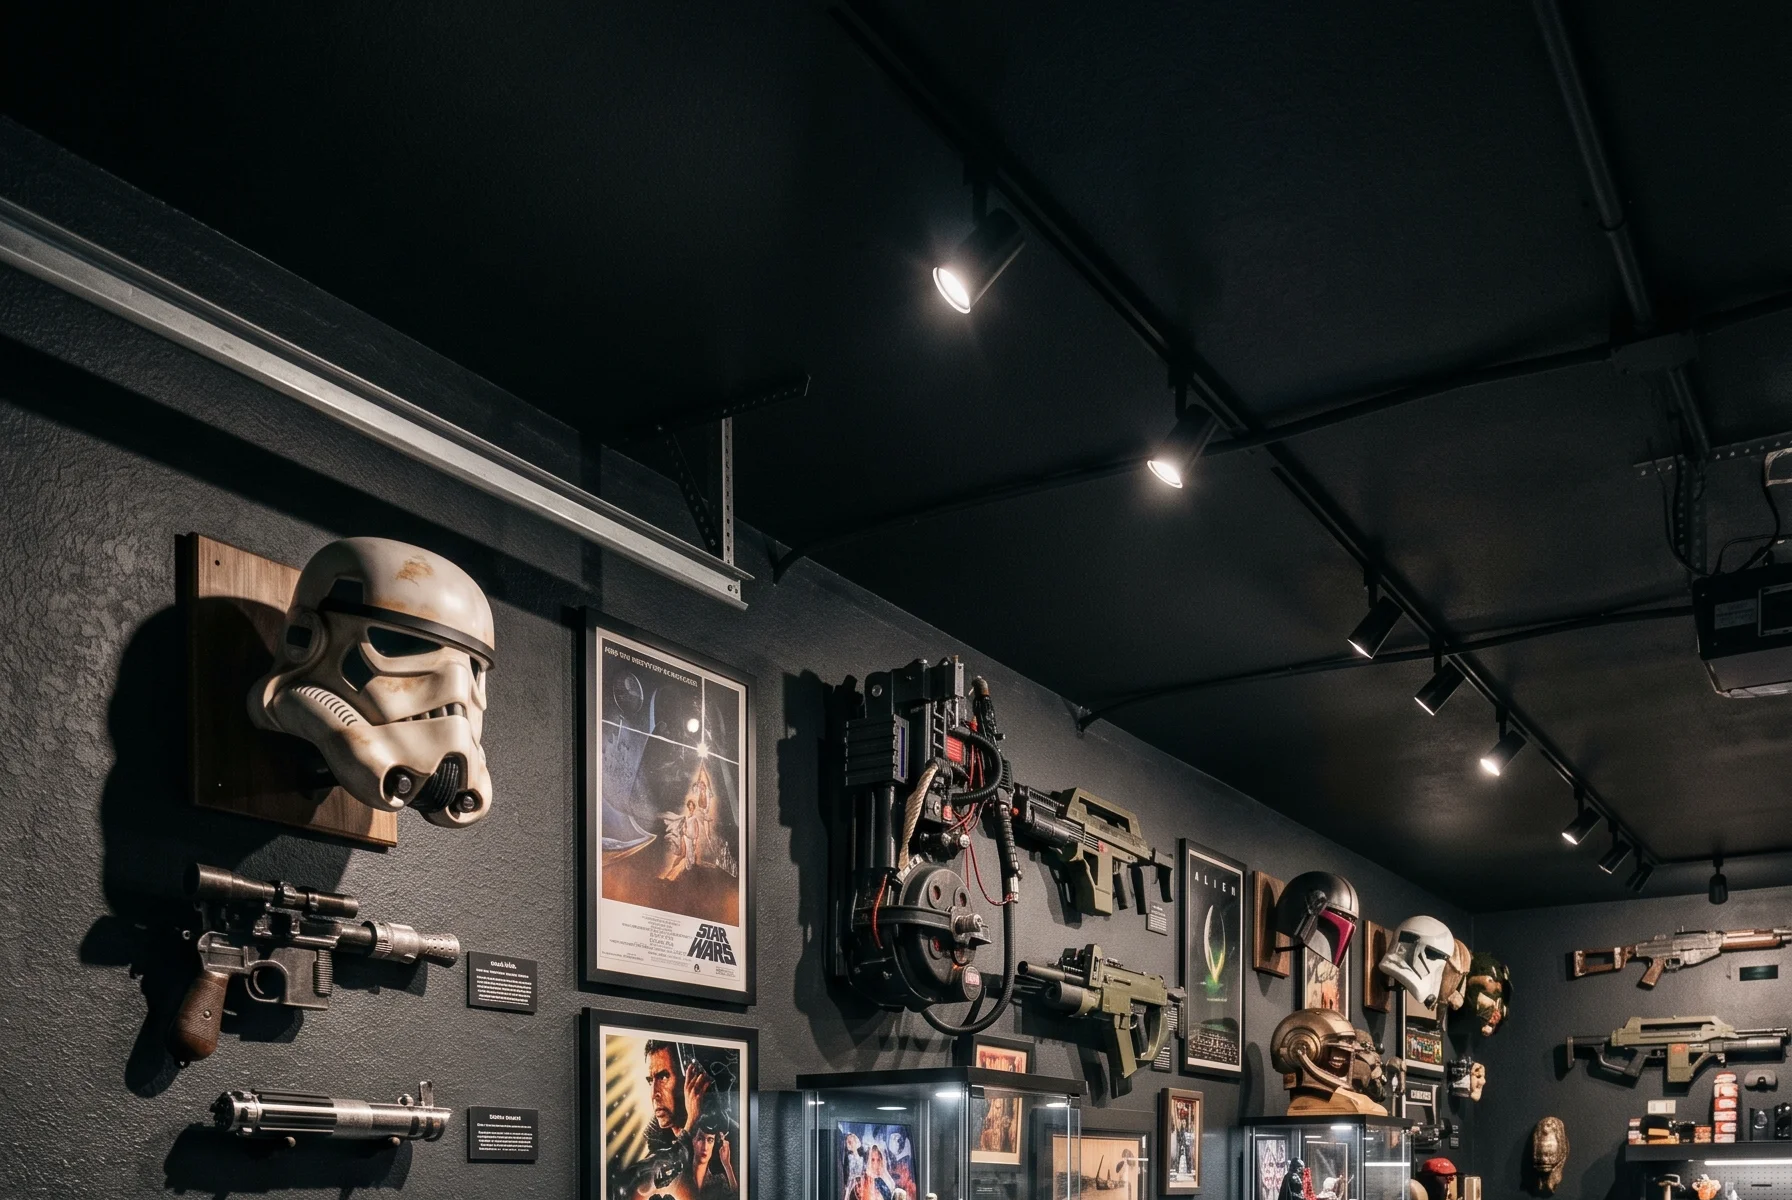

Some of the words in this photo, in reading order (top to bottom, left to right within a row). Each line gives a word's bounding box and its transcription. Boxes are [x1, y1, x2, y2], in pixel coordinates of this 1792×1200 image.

[1194, 871, 1236, 897] ALIEN
[695, 923, 729, 945] STAR
[686, 937, 737, 966] WARS
